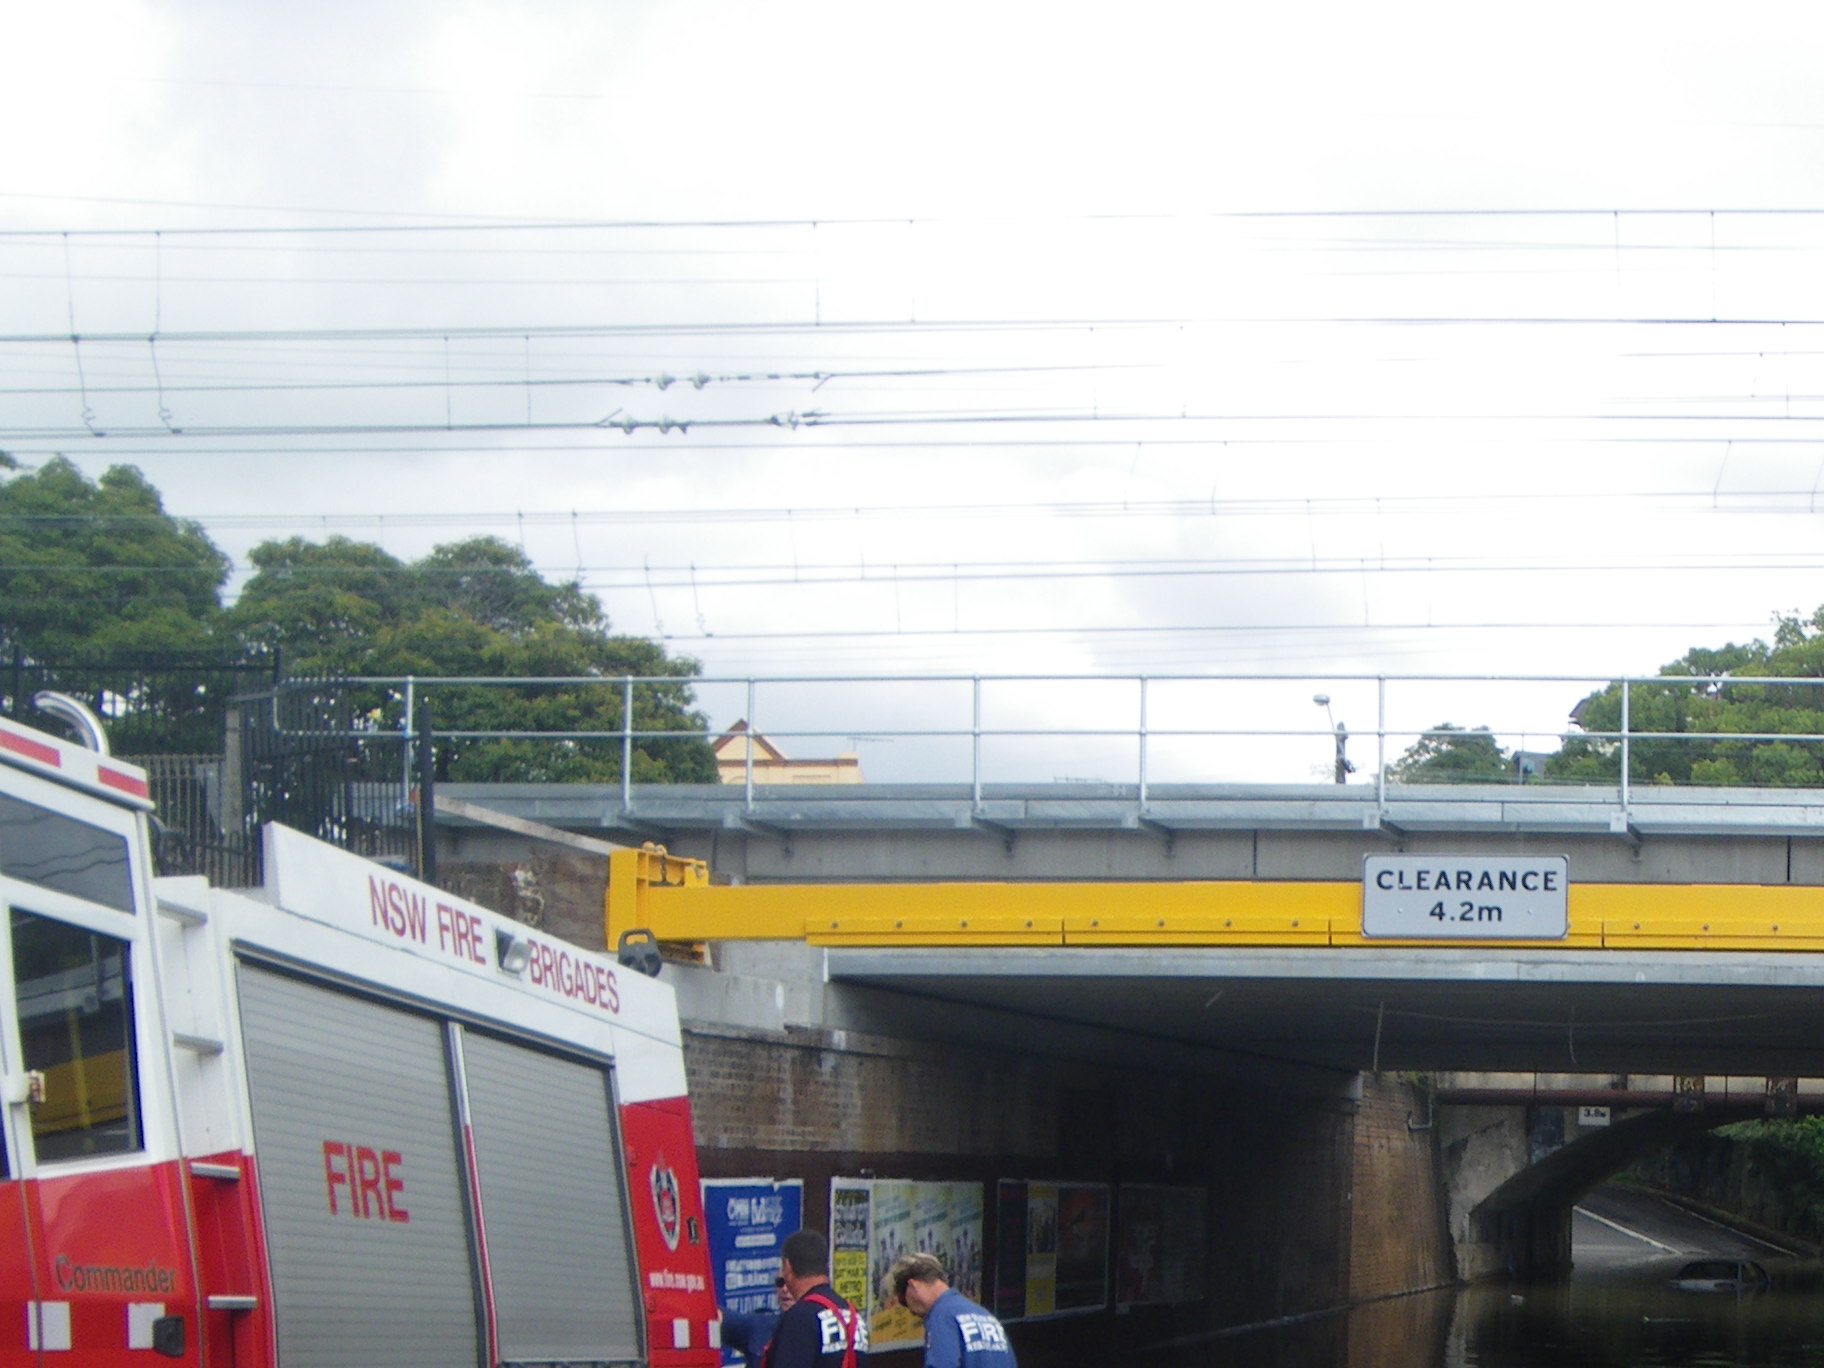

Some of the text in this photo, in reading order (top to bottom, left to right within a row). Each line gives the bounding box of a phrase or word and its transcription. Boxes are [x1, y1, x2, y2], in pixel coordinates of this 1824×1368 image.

[1376, 870, 1558, 892] CLEARANCE
[1429, 901, 1503, 922] 4.2m
[368, 874, 621, 1014] NSW FIRE BRIGADES
[323, 1140, 410, 1224] FIRE
[55, 1252, 176, 1293] Commander
